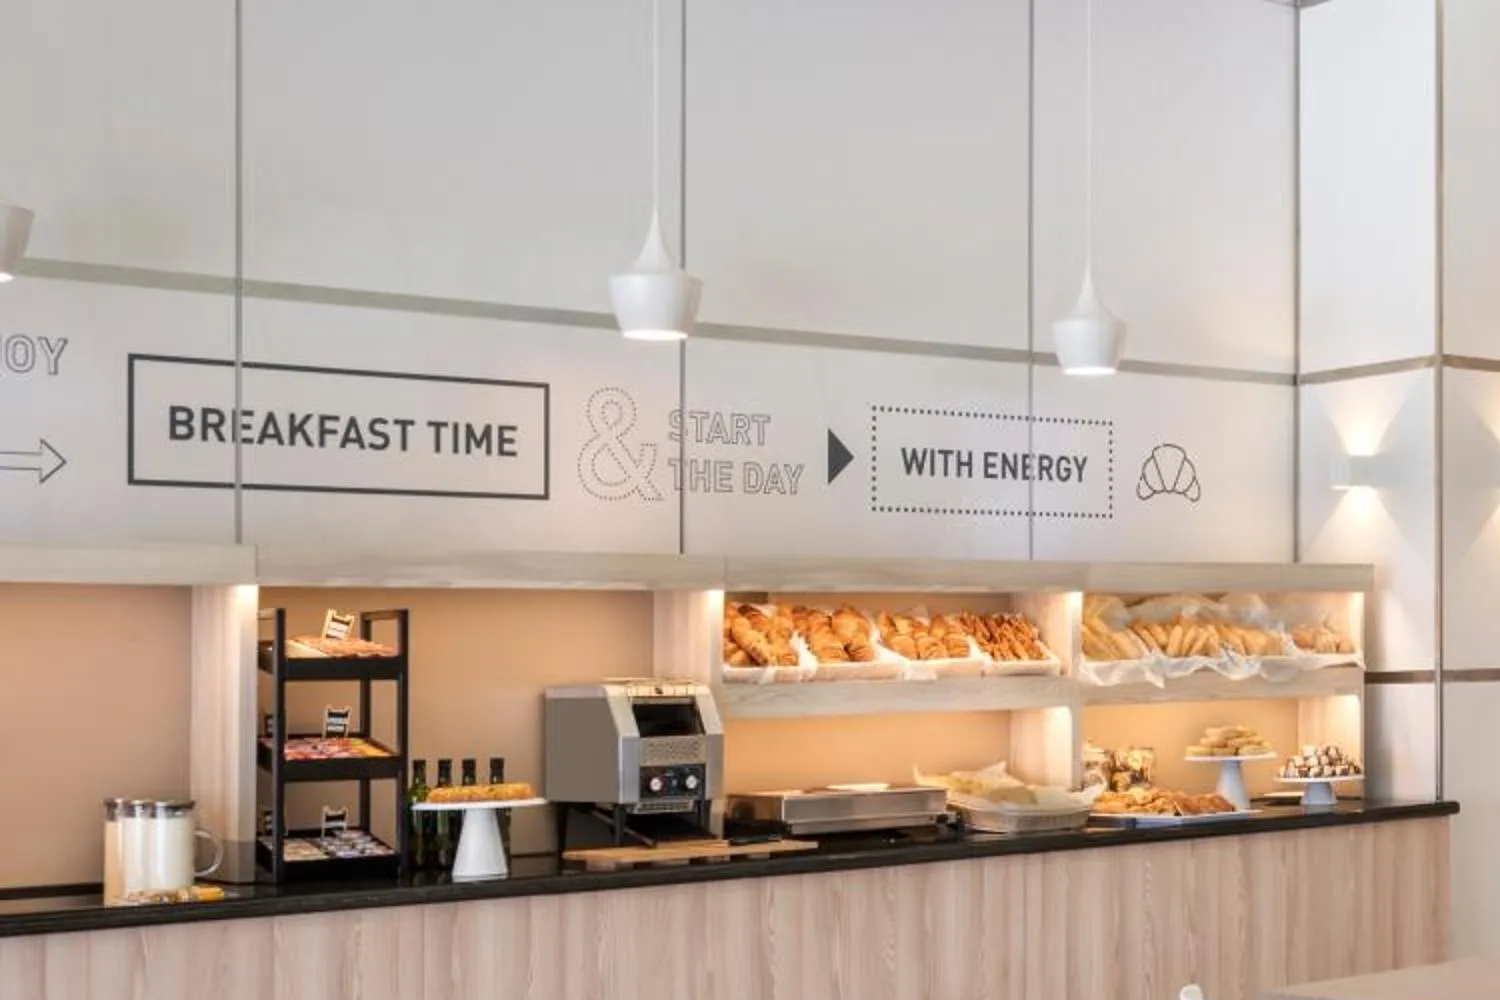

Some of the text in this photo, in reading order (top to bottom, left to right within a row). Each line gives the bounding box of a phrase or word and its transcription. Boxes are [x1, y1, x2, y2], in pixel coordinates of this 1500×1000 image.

[0, 333, 69, 376] OY
[168, 404, 519, 458] BREAKFAST TIME
[667, 408, 772, 447] START
[667, 455, 807, 496] THE DAY
[900, 446, 1089, 484] WITH ENERGY
